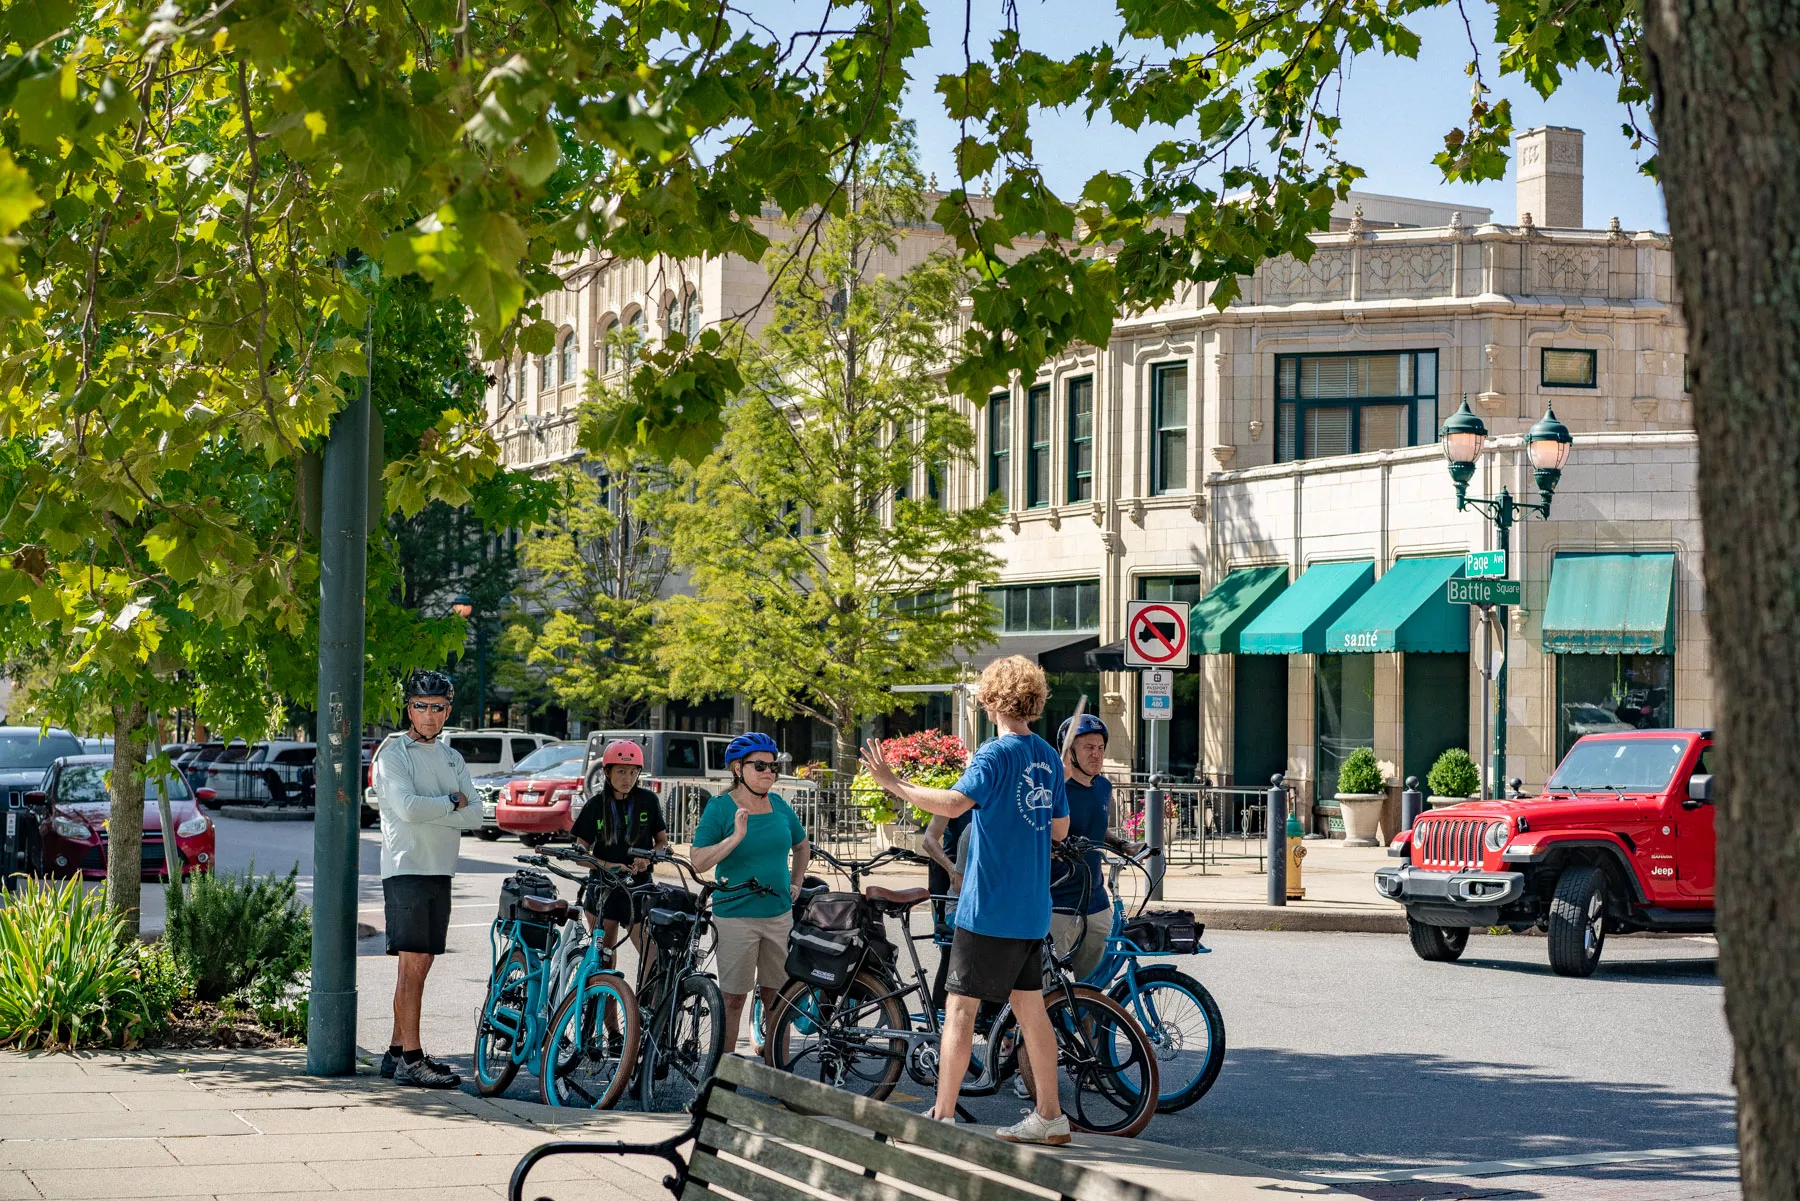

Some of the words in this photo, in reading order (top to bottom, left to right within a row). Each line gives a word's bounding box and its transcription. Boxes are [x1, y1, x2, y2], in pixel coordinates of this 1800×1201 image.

[1467, 554, 1489, 575] Page
[1493, 554, 1504, 564] Ave
[1450, 581, 1491, 601] Battle
[1496, 583, 1520, 595] Square
[1344, 629, 1378, 647] santé
[1651, 866, 1674, 877] Jeep
